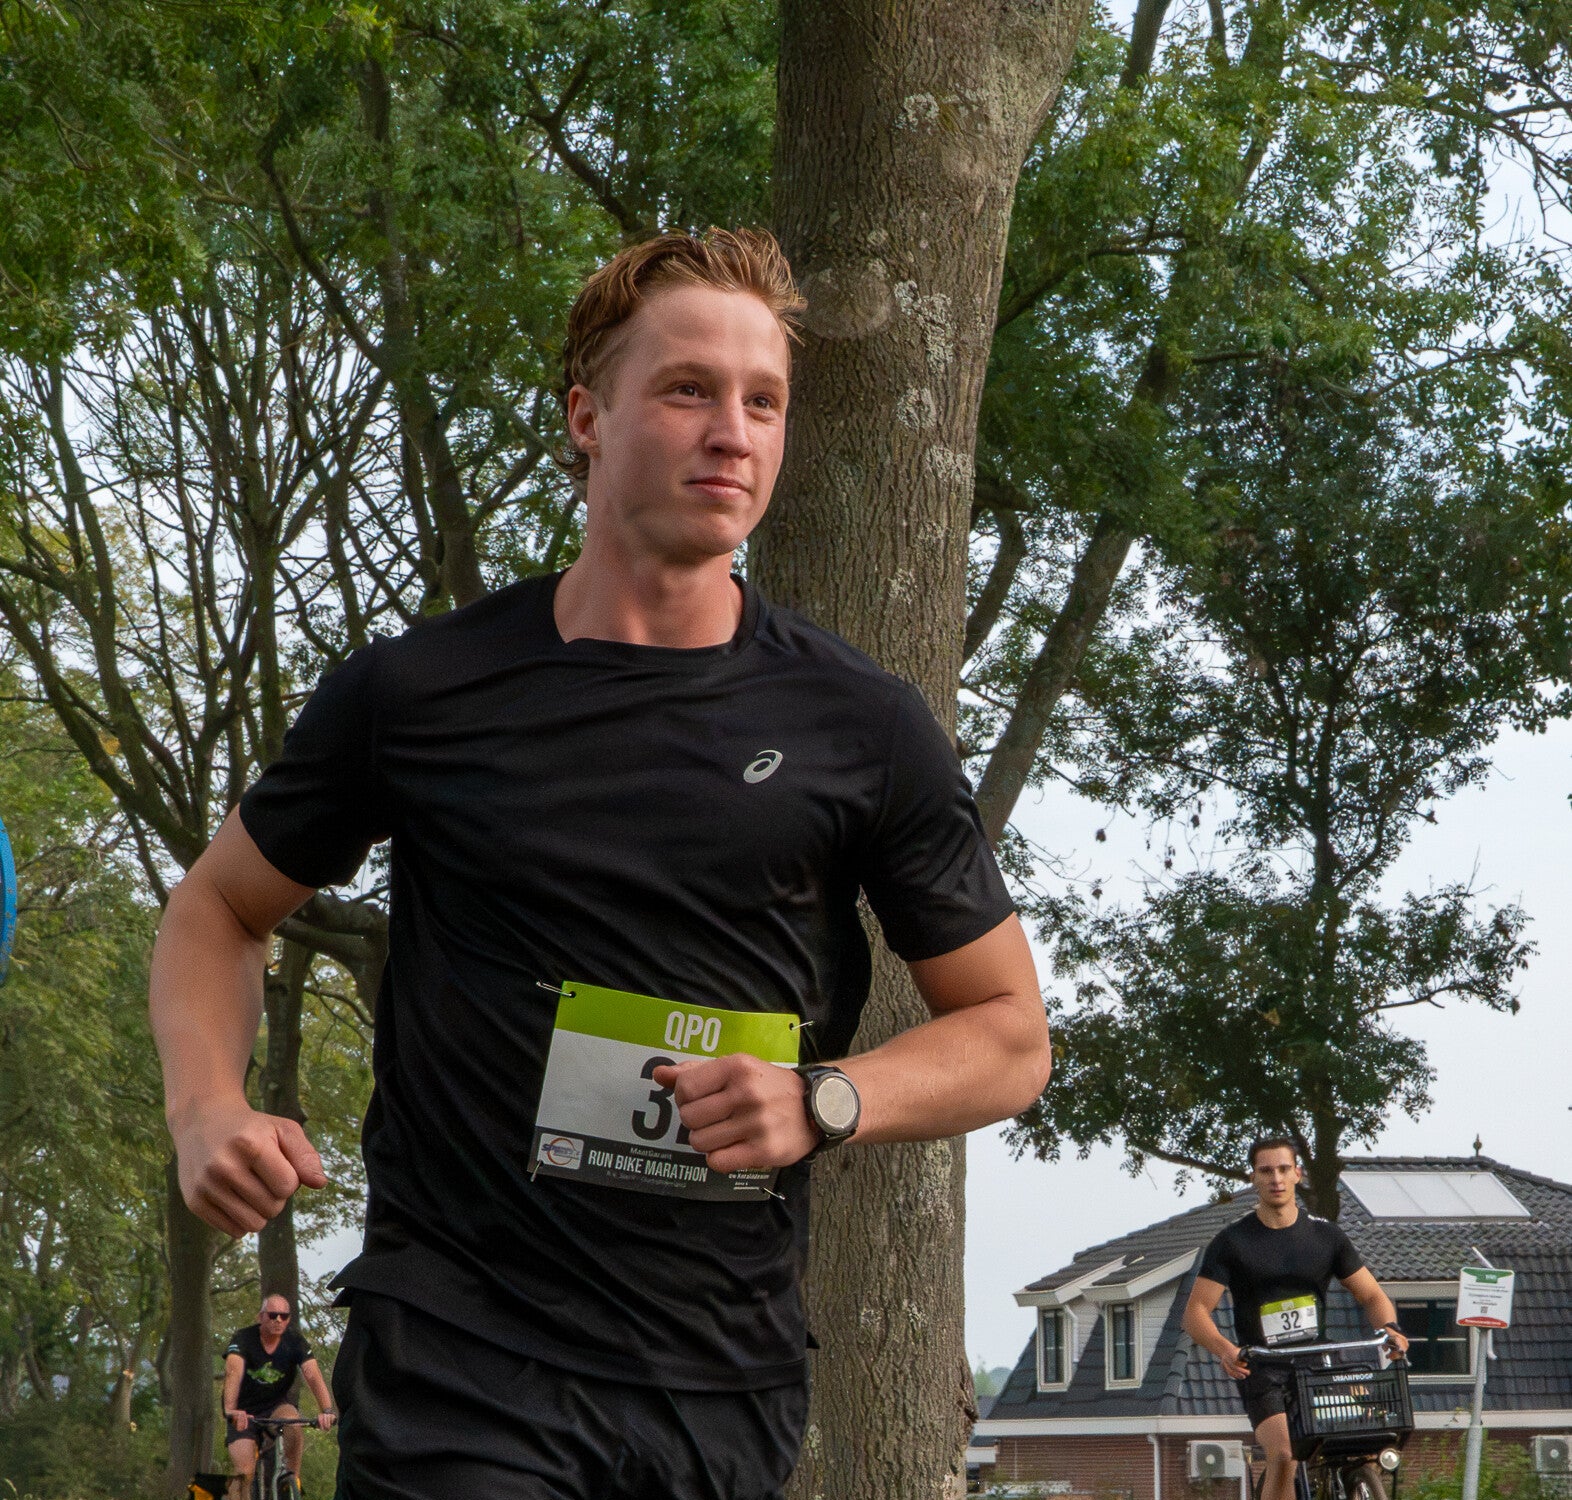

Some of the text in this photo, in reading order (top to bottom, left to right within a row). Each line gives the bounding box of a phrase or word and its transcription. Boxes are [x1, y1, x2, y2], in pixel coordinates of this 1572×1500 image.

[664, 1011, 721, 1052] QPO
[631, 1056, 692, 1145] 3
[587, 1150, 614, 1169] RUN
[615, 1155, 644, 1174] BIKE
[644, 1160, 708, 1182] MARATHON
[1280, 1310, 1301, 1331] 32
